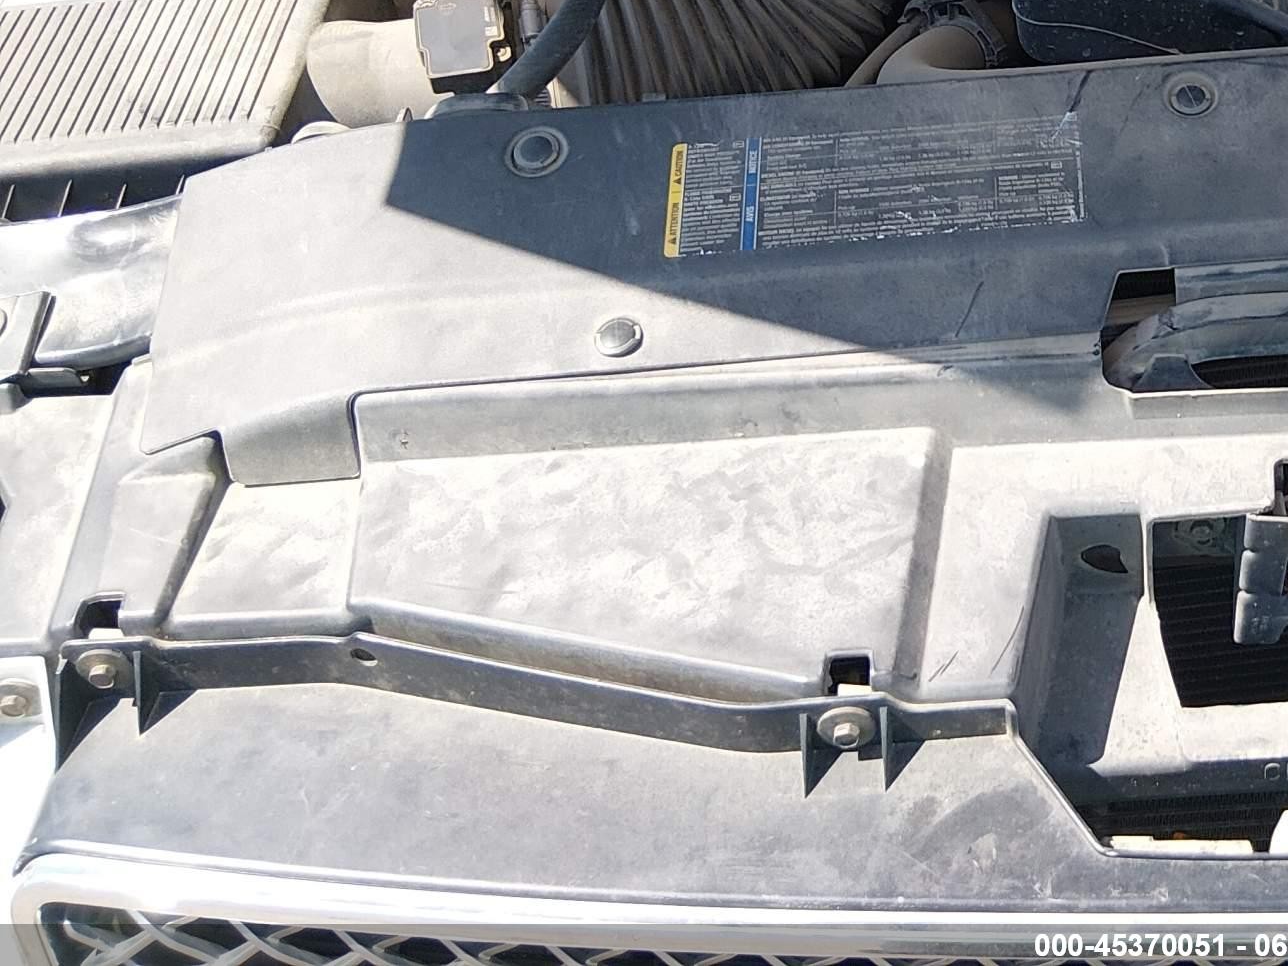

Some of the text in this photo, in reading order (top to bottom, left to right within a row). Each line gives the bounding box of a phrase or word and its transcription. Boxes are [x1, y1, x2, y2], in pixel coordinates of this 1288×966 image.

[674, 150, 683, 177] CAUTION
[748, 150, 758, 174] NOTICE
[669, 202, 680, 236] ATTENTION
